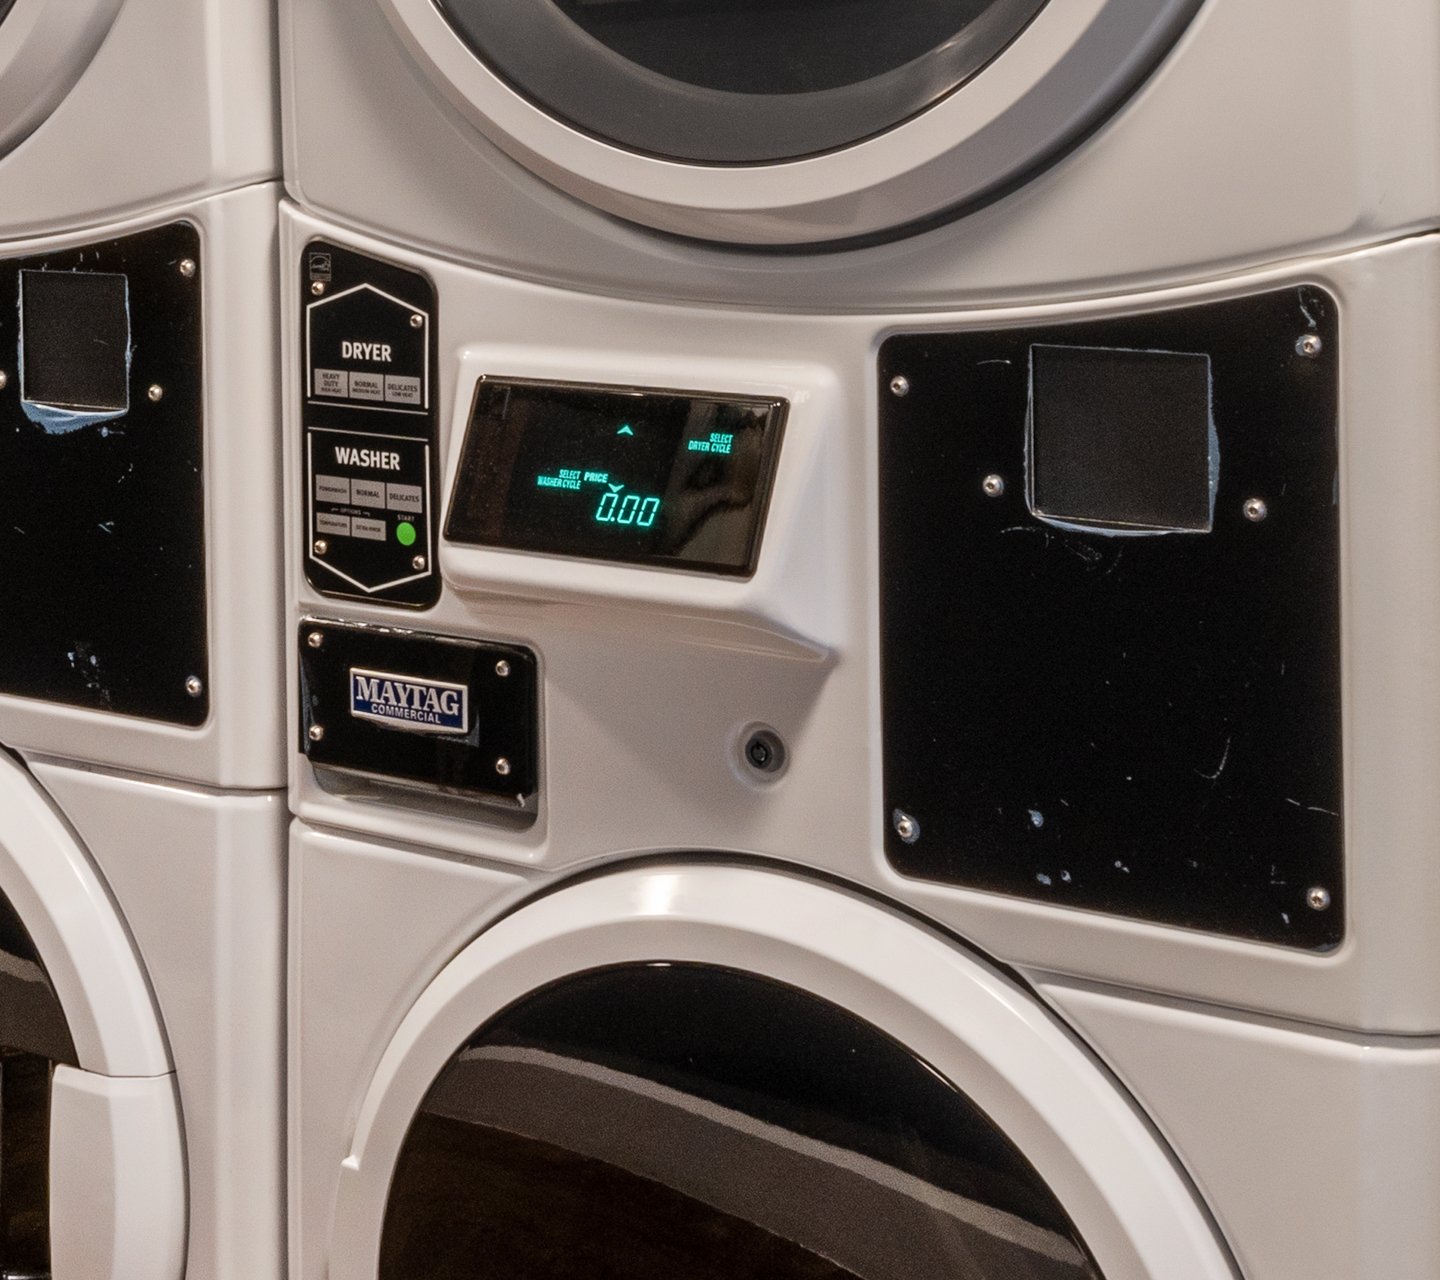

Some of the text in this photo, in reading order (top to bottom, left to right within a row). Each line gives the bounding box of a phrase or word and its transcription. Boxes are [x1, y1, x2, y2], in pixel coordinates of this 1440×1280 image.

[342, 340, 392, 362] DRYER
[688, 441, 732, 454] DRYER CYCLE
[710, 432, 733, 443] SELECT
[335, 446, 400, 471] WASHER
[559, 469, 581, 479] SELECT
[584, 472, 608, 483] PRICE
[596, 493, 660, 527] 0.00
[356, 676, 459, 716] MAYTAG
[371, 704, 441, 724] COMMERCIAL
